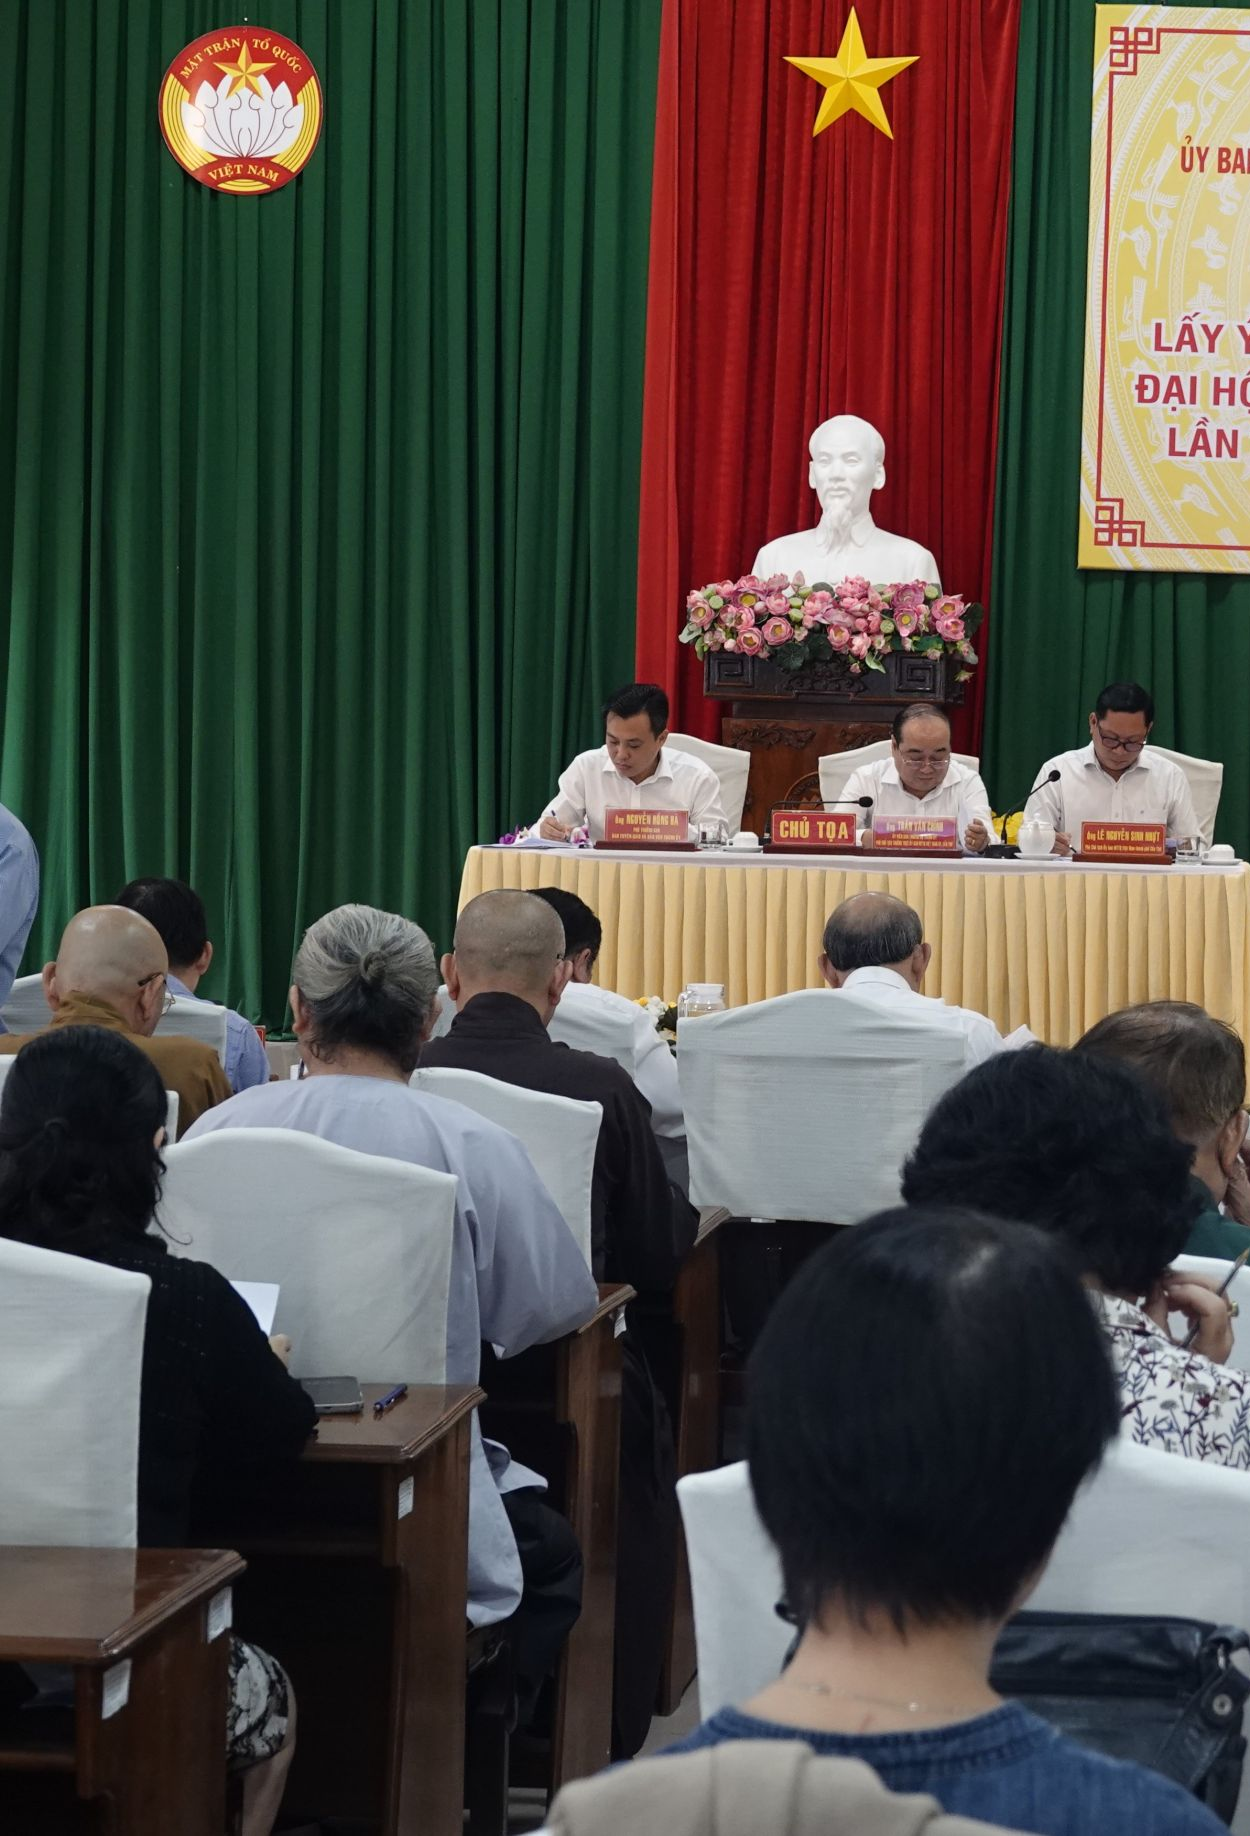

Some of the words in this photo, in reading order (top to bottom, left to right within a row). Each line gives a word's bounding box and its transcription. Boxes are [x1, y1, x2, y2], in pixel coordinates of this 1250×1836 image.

[180, 51, 204, 79] MẶT
[204, 38, 241, 56] TRẬN
[252, 38, 272, 51] TỔ
[272, 44, 302, 74] QUỐC
[208, 163, 243, 181] VIỆT
[248, 164, 279, 182] NAM
[1180, 135, 1210, 173] ỦY
[1153, 312, 1224, 354] LẤY
[1135, 374, 1198, 412] ĐẠI
[1168, 417, 1238, 458] LẦN
[779, 816, 810, 839] CHỦ
[817, 821, 849, 843] TỌA
